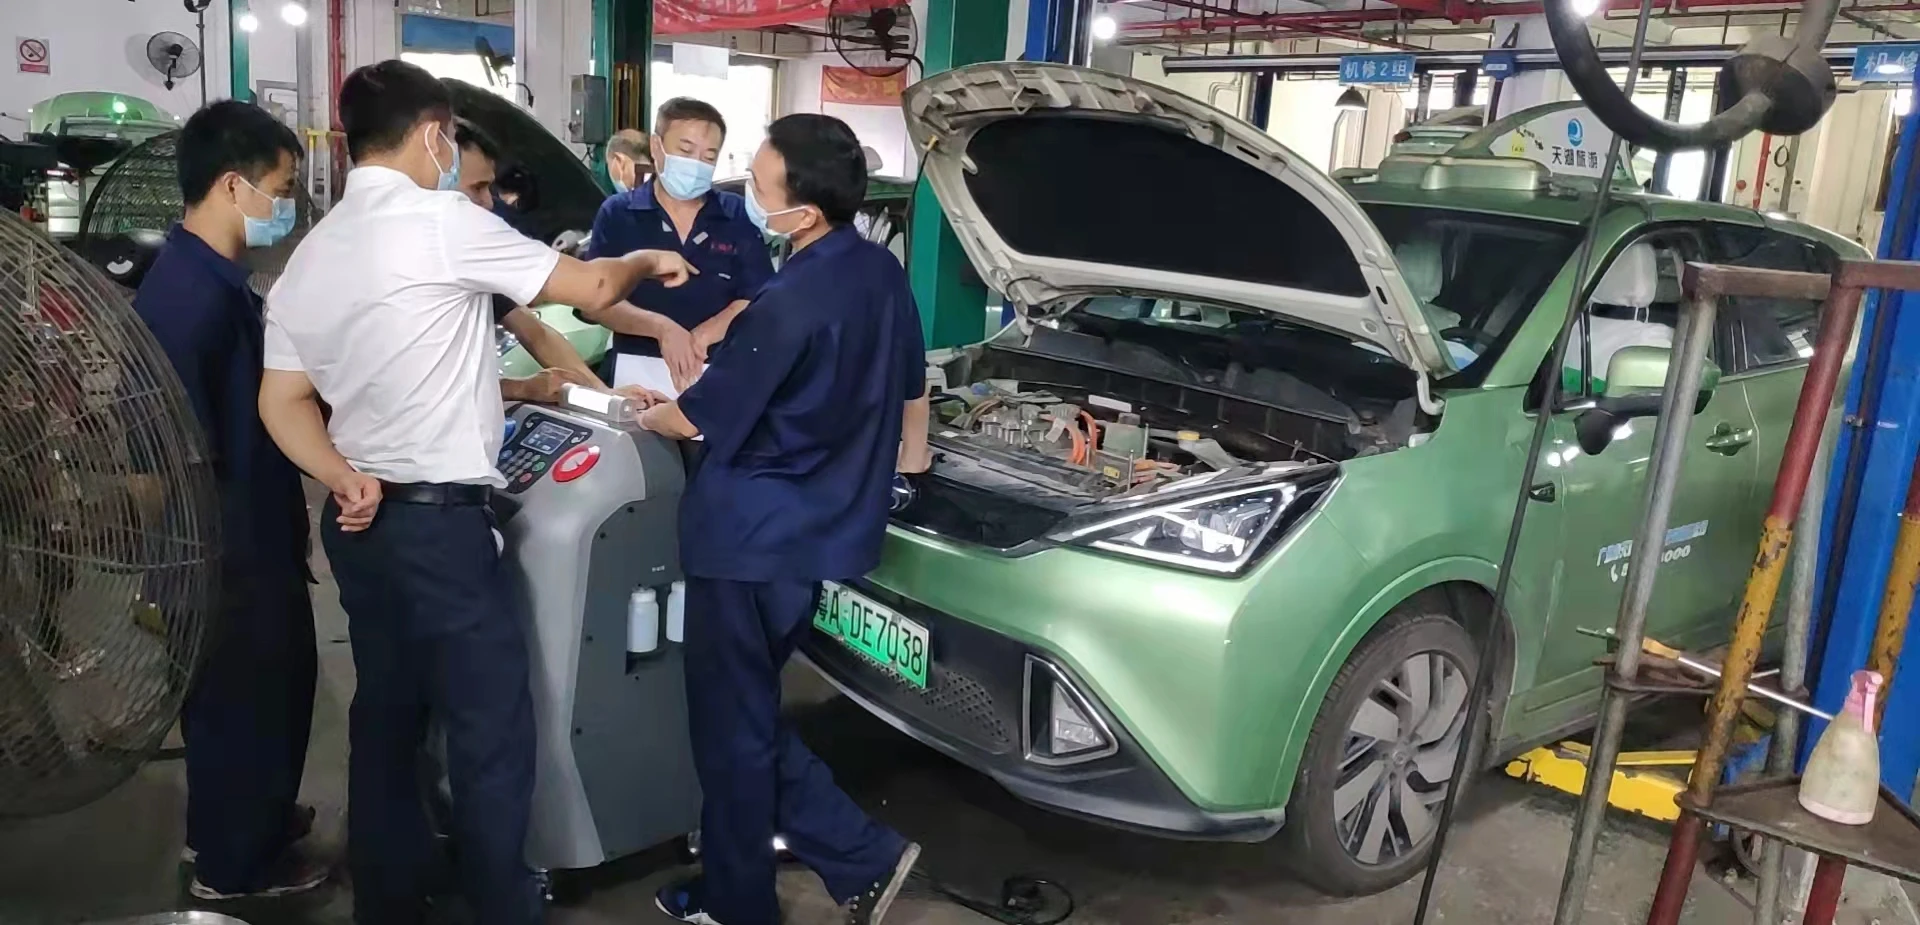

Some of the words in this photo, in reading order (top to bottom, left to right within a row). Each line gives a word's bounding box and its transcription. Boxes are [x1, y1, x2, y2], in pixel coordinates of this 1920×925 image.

[1345, 60, 1408, 79] 机修2组
[1551, 145, 1599, 169] 天湖旅游
